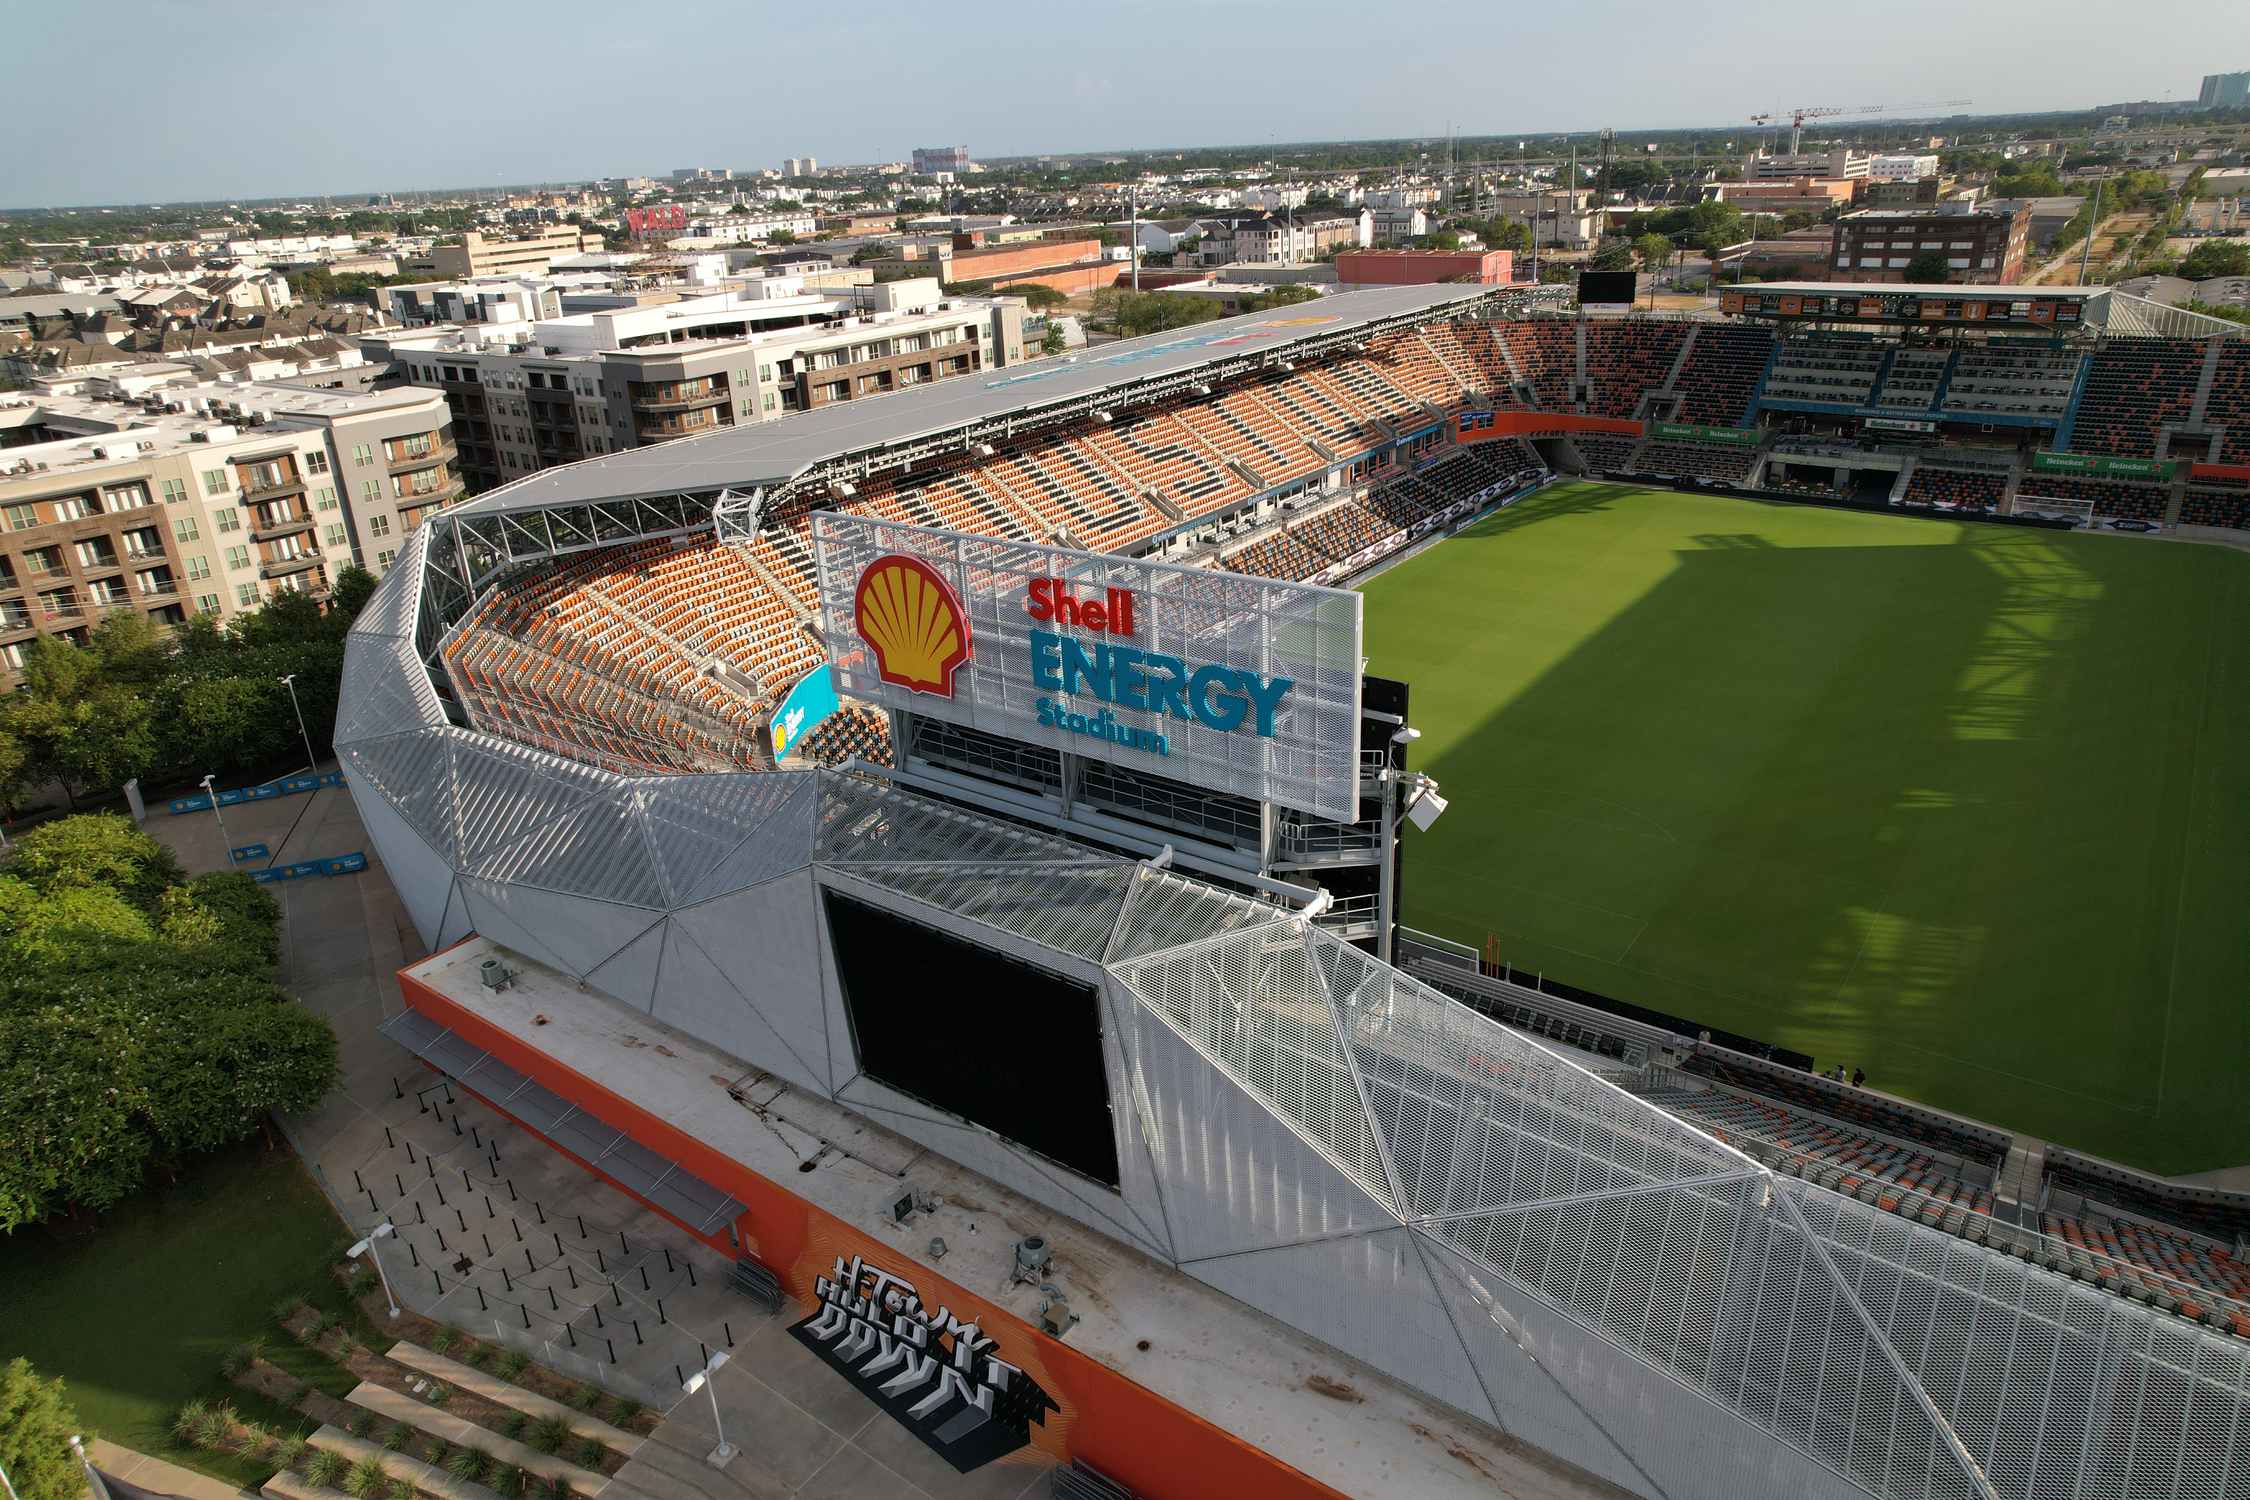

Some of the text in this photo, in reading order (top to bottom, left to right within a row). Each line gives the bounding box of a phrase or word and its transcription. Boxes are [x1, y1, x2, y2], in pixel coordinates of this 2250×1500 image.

[2046, 457, 2148, 471] Heineken Heineken
[1028, 577, 1135, 637] Shell
[1030, 629, 1296, 738] ENERGY
[1035, 697, 1169, 756] Stadium
